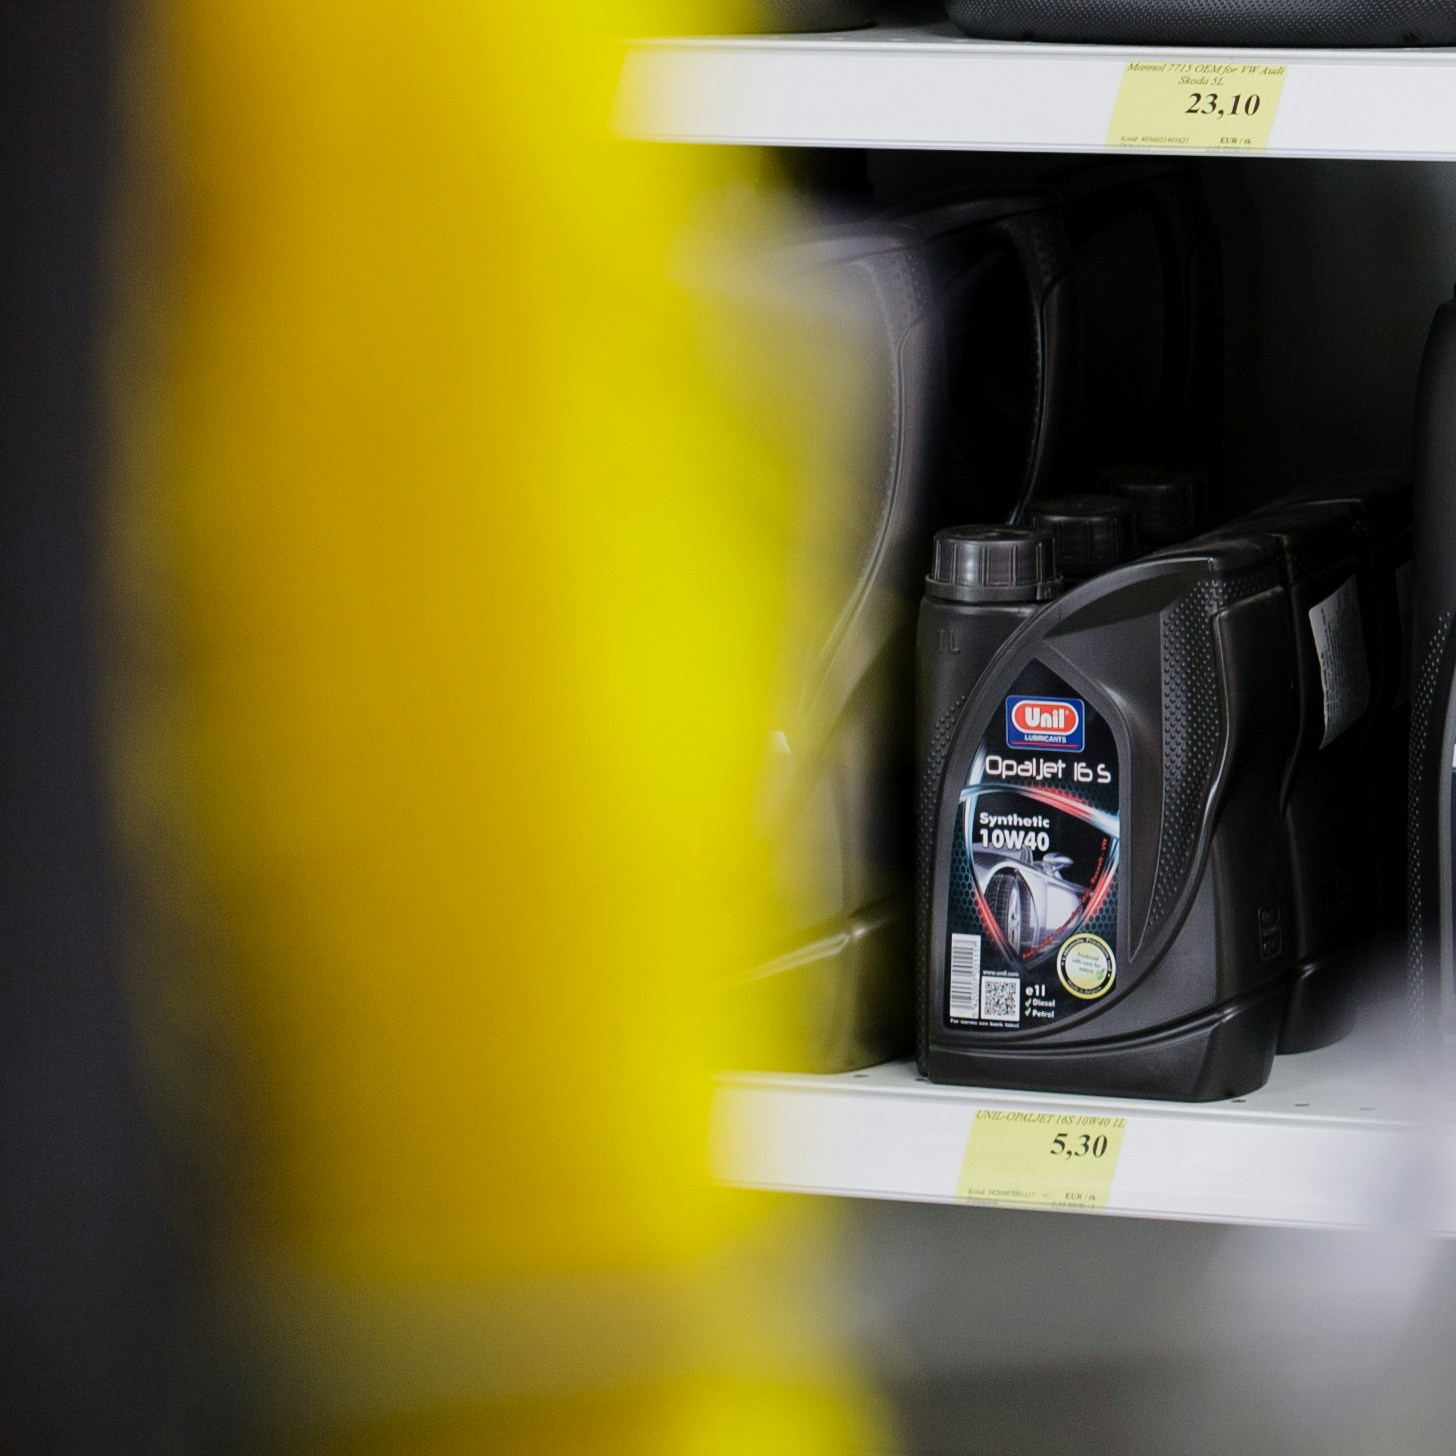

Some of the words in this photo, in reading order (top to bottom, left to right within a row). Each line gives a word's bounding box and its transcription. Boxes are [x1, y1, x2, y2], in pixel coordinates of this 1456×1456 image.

[1185, 92, 1260, 120] 23,10
[1025, 707, 1065, 729] Unil
[1024, 734, 1067, 744] LUBRICANTS
[985, 755, 1066, 781] Opaljet
[1073, 762, 1093, 782] 16
[1097, 764, 1111, 784] S
[979, 812, 1050, 829] Synthetic
[980, 829, 1050, 852] 10W40
[1050, 1132, 1108, 1161] 5,30
